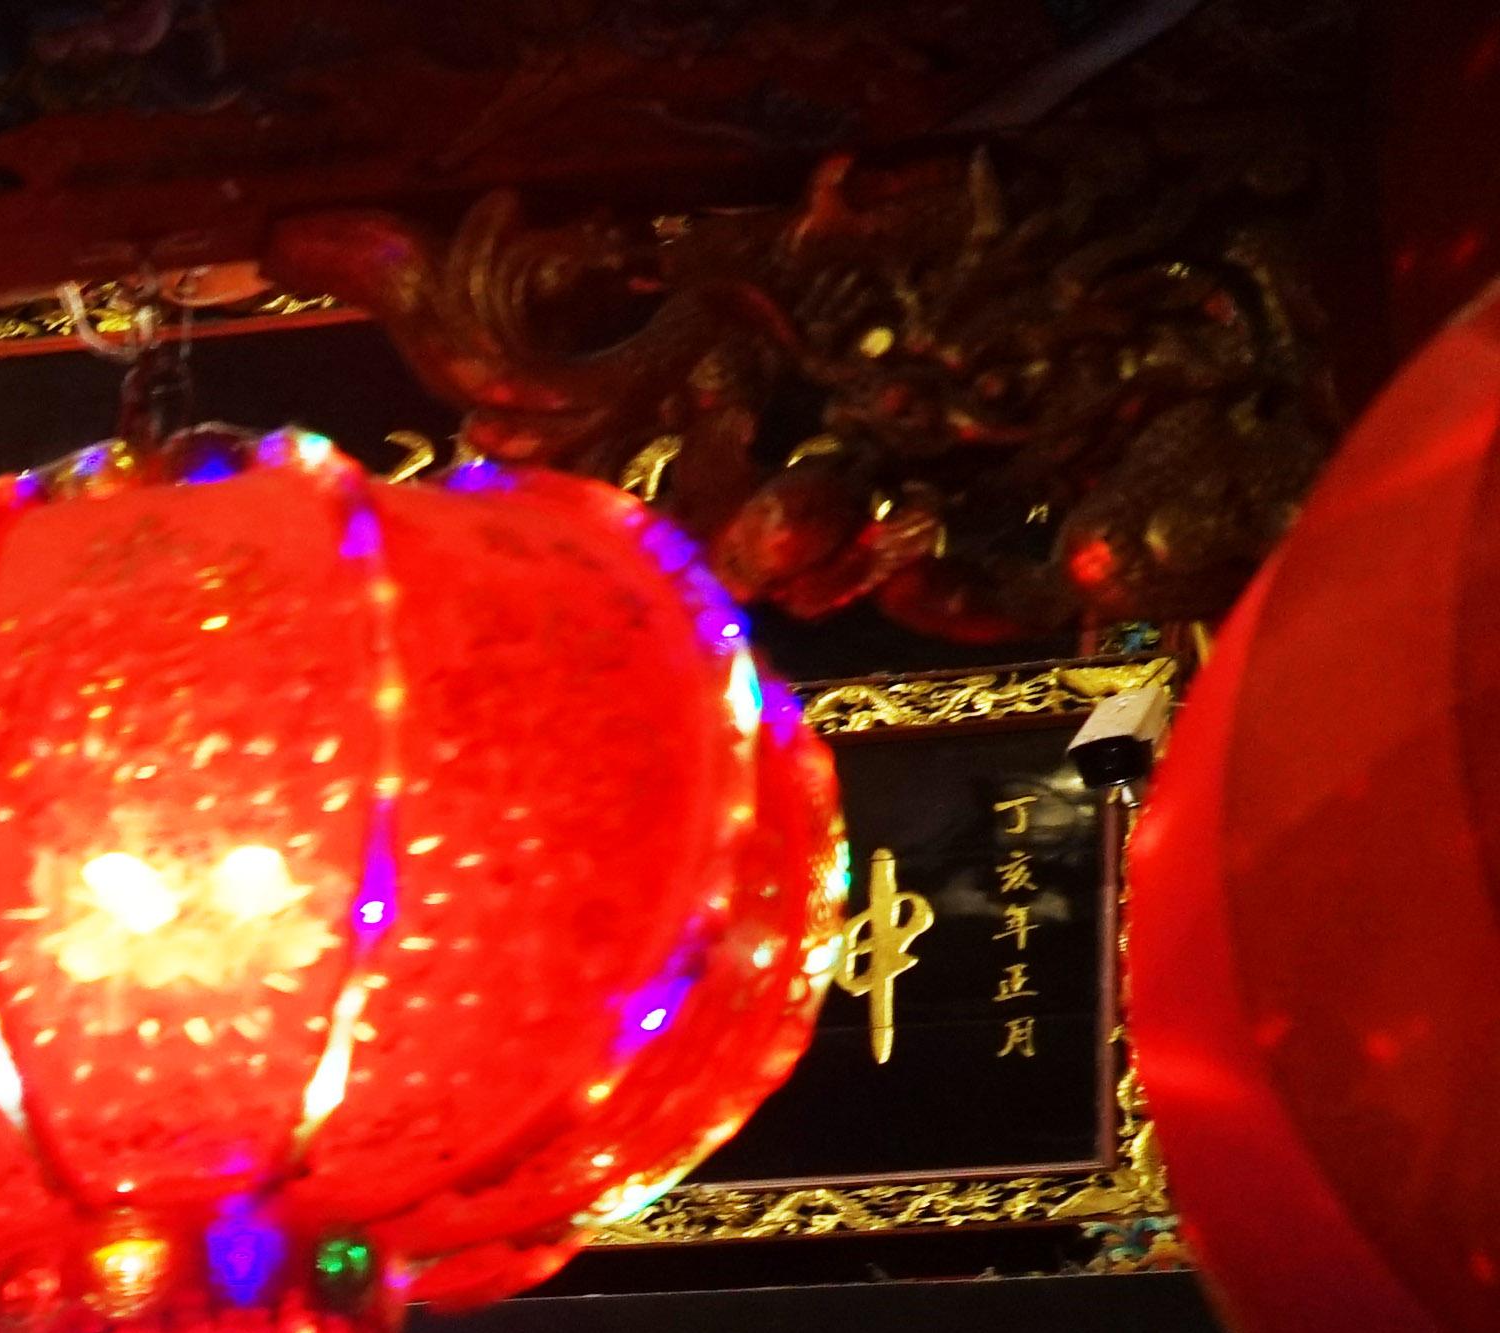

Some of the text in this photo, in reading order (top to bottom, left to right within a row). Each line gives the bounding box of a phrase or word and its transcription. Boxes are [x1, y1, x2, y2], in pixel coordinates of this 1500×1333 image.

[992, 795, 1040, 1060] 丁亥年正月
